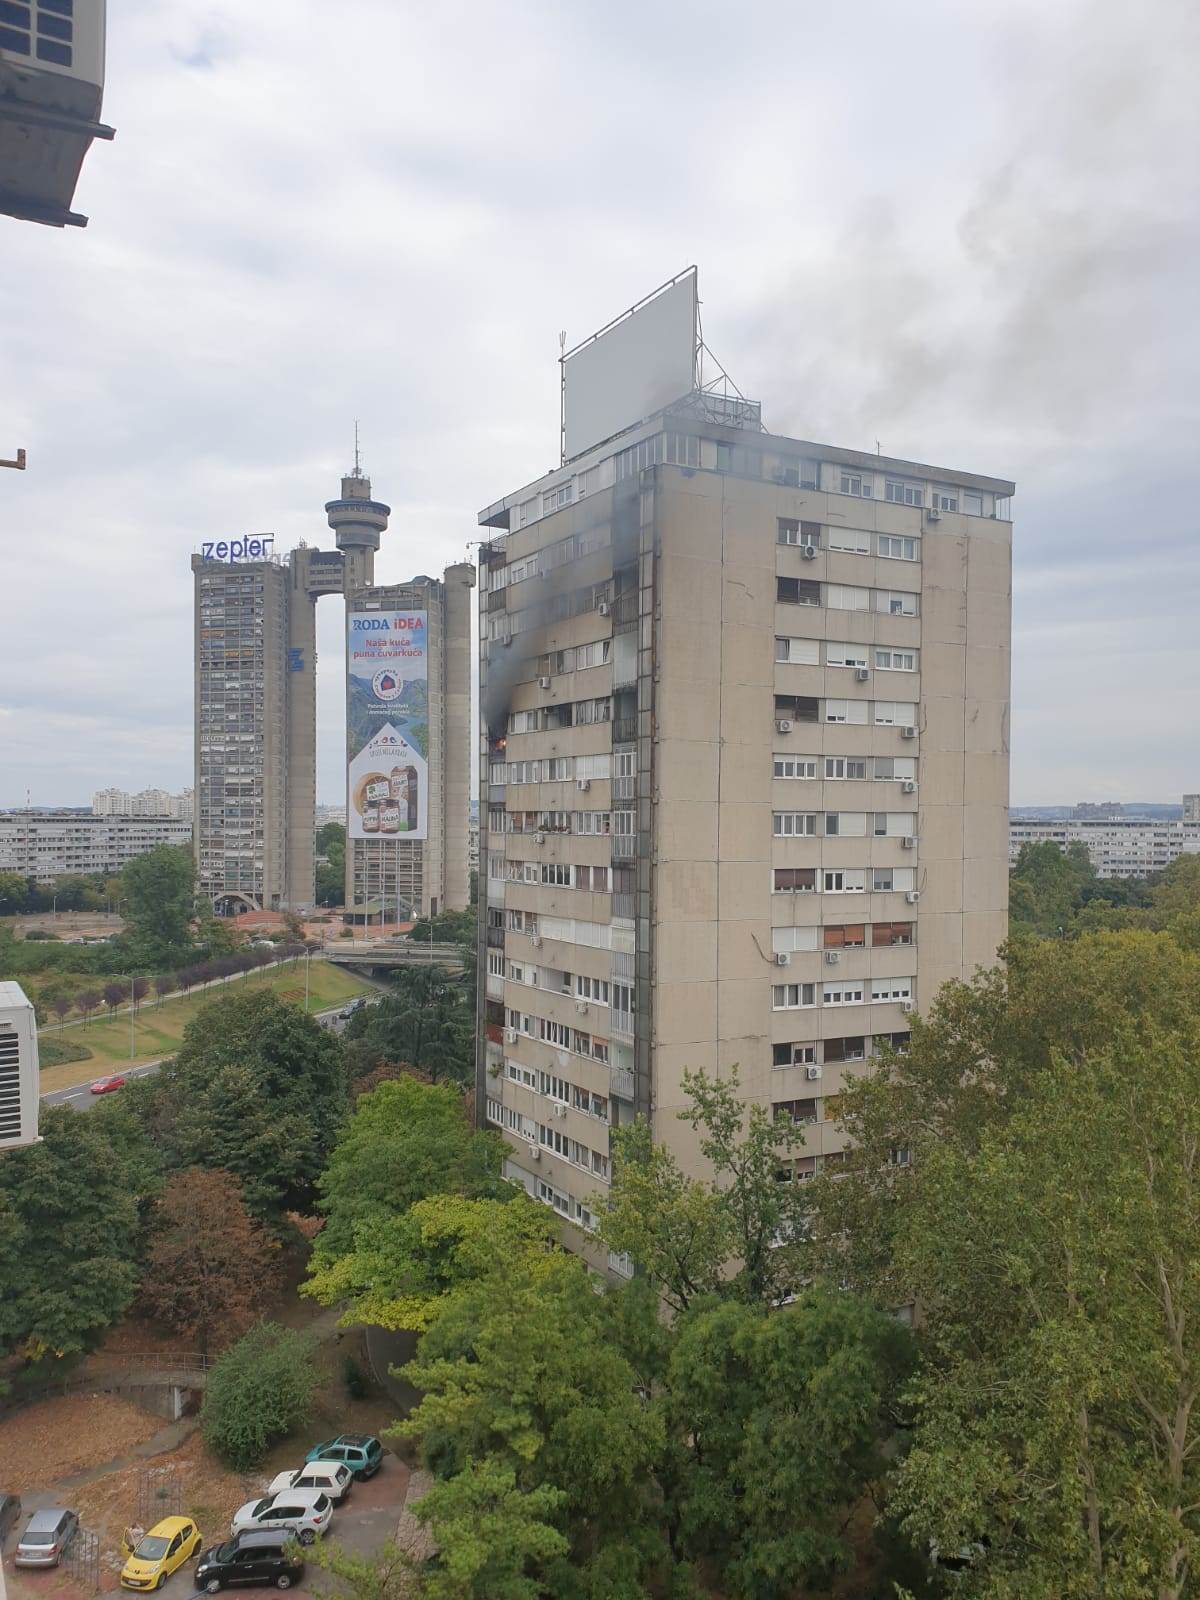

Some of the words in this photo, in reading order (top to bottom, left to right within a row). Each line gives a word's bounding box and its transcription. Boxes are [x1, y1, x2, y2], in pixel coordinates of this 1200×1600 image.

[203, 534, 274, 565] zepter
[353, 619, 390, 631] RODA
[366, 638, 387, 647] Naša
[389, 638, 411, 646] kuća
[353, 651, 375, 659] puna
[377, 649, 423, 657] čuvarkuća
